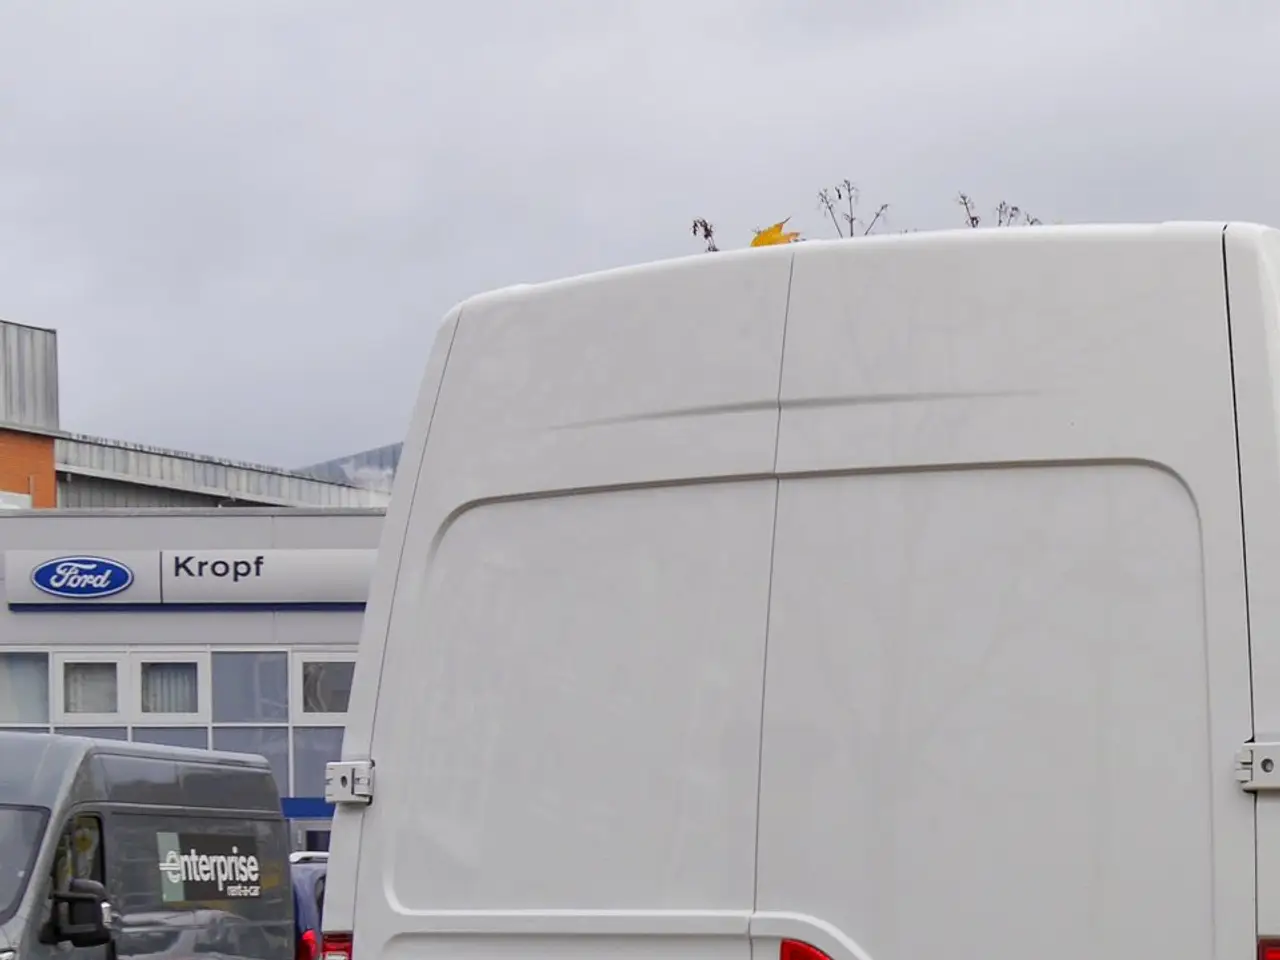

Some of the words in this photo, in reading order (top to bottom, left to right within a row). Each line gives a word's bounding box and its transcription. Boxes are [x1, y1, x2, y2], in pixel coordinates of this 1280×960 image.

[50, 562, 111, 589] Ford
[174, 556, 264, 582] Kropf
[159, 846, 259, 891] enterprise
